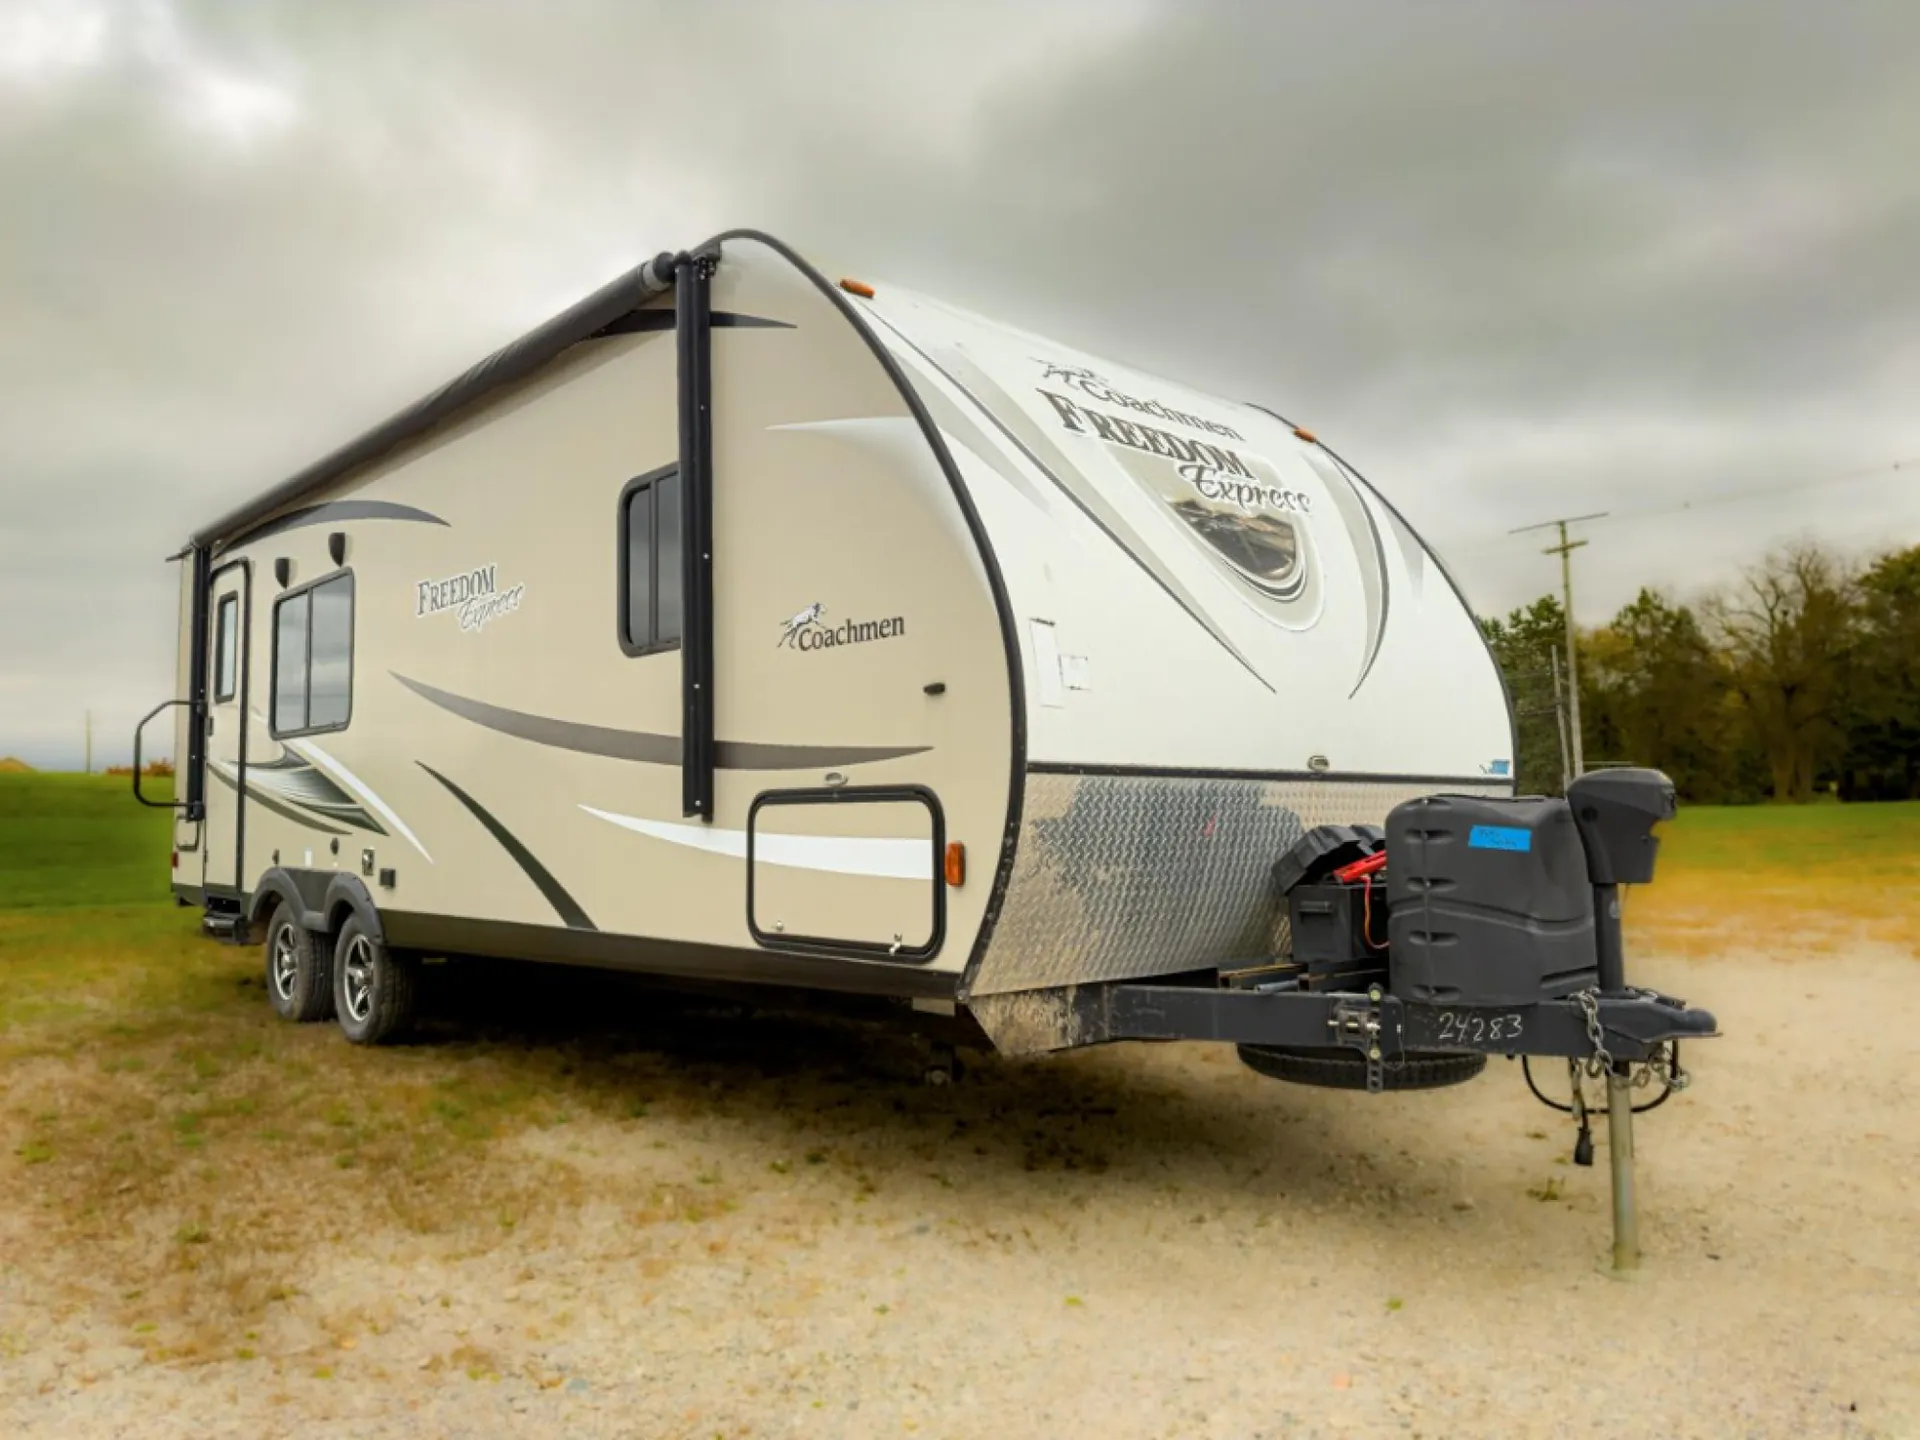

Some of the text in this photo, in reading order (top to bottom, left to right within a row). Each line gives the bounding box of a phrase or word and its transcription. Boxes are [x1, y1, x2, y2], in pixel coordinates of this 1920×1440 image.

[1035, 387, 1258, 481] FREEDOM
[1080, 379, 1247, 442] Coachmen
[1178, 464, 1311, 513] Express
[417, 564, 496, 616] FREEDOM
[458, 584, 524, 630] Express
[799, 616, 905, 652] Coachmen
[1439, 1012, 1523, 1042] 24283
